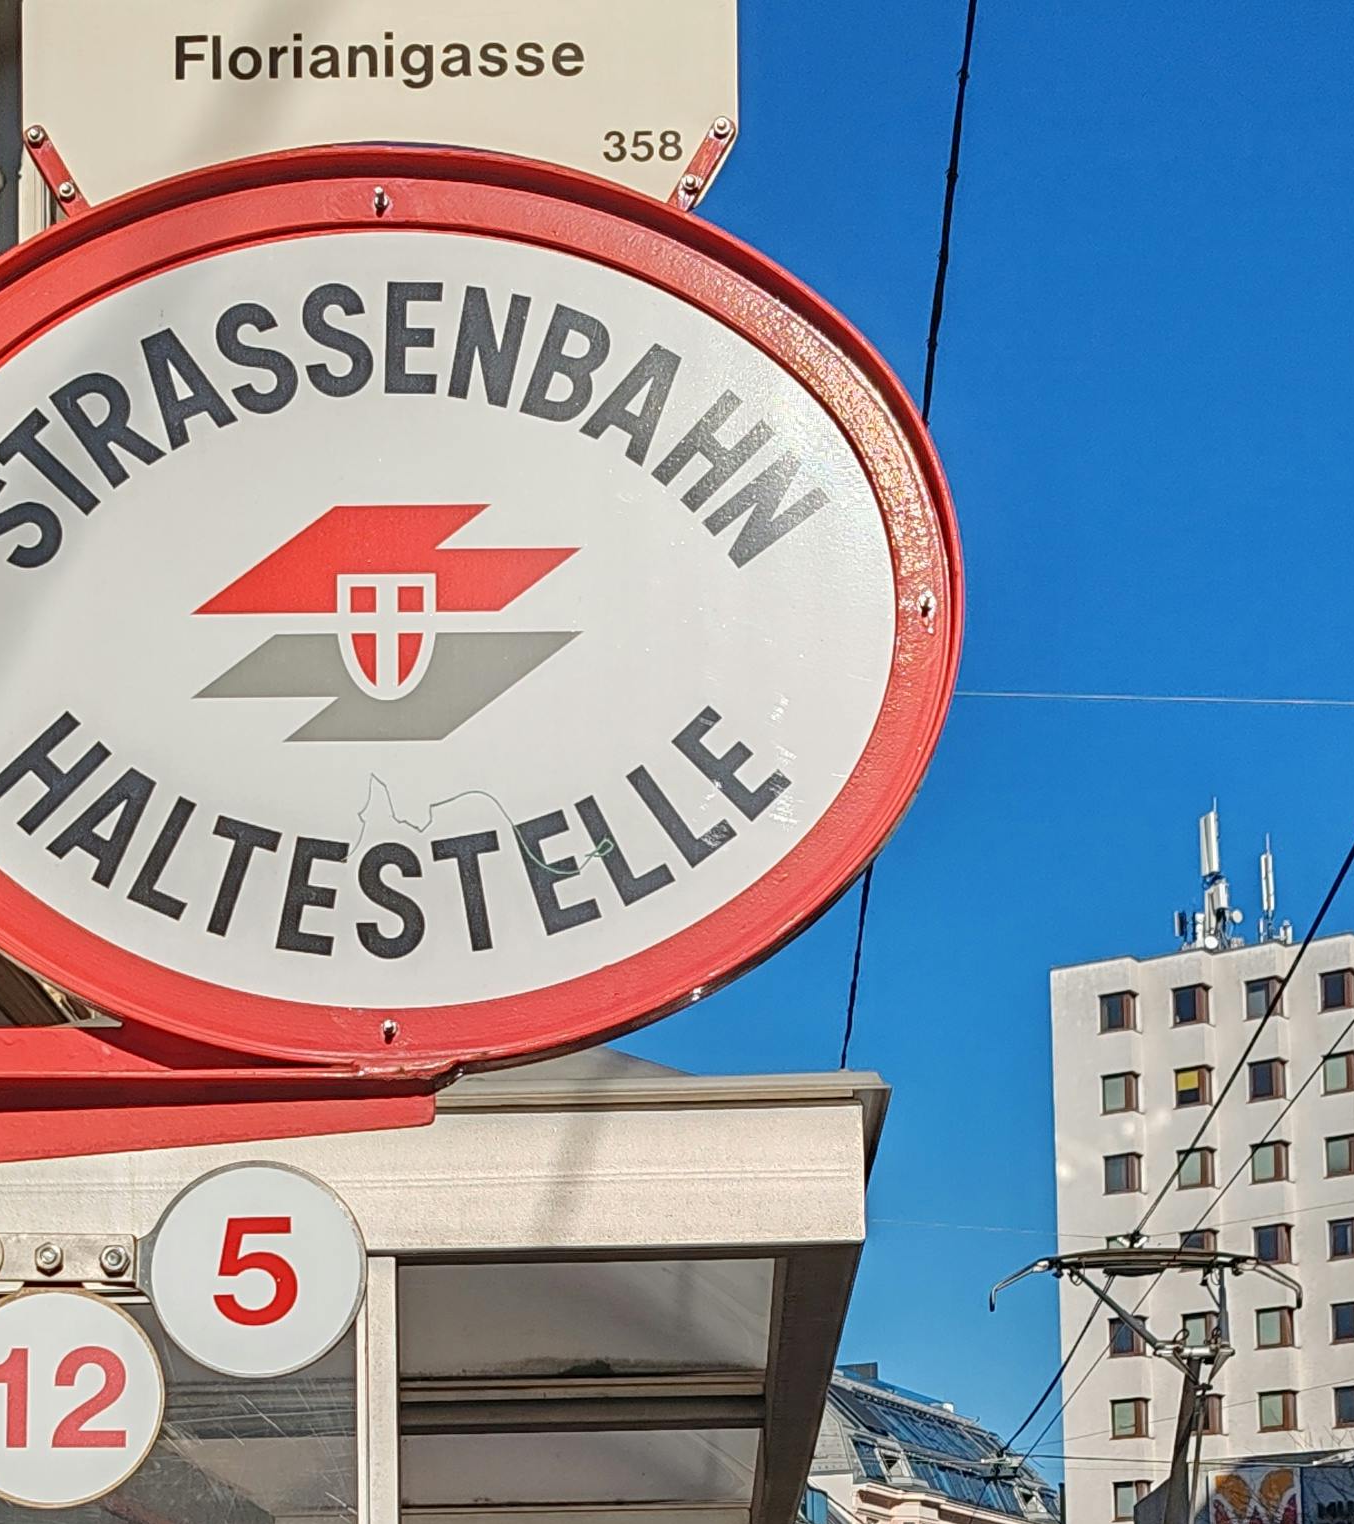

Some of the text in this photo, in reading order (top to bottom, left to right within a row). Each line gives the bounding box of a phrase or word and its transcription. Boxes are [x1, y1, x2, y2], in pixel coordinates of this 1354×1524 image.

[174, 32, 586, 89] Florianigasse
[602, 129, 684, 163] 358
[212, 1215, 299, 1327] 5
